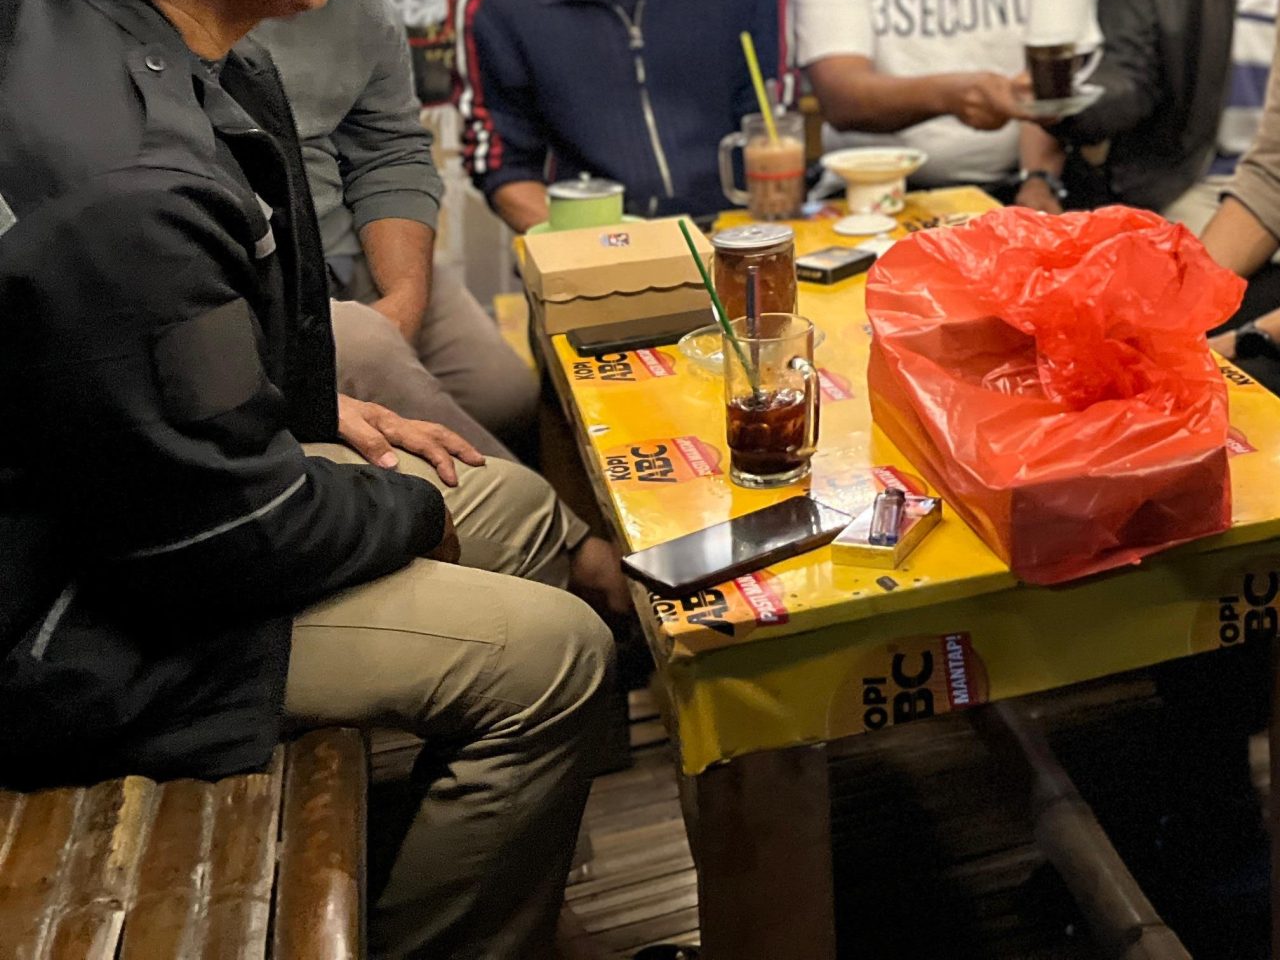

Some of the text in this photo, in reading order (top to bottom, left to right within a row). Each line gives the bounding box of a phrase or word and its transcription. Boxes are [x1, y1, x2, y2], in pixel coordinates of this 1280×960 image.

[572, 361, 595, 381] KOPI
[594, 351, 636, 382] ABC
[605, 455, 632, 481] KOPI
[630, 444, 678, 483] ABC
[681, 588, 735, 637] AB
[1219, 595, 1240, 644] OPI
[1243, 570, 1279, 640] BC
[892, 650, 934, 725] BC
[945, 635, 970, 705] MANTAP!
[863, 677, 888, 732] OPI
